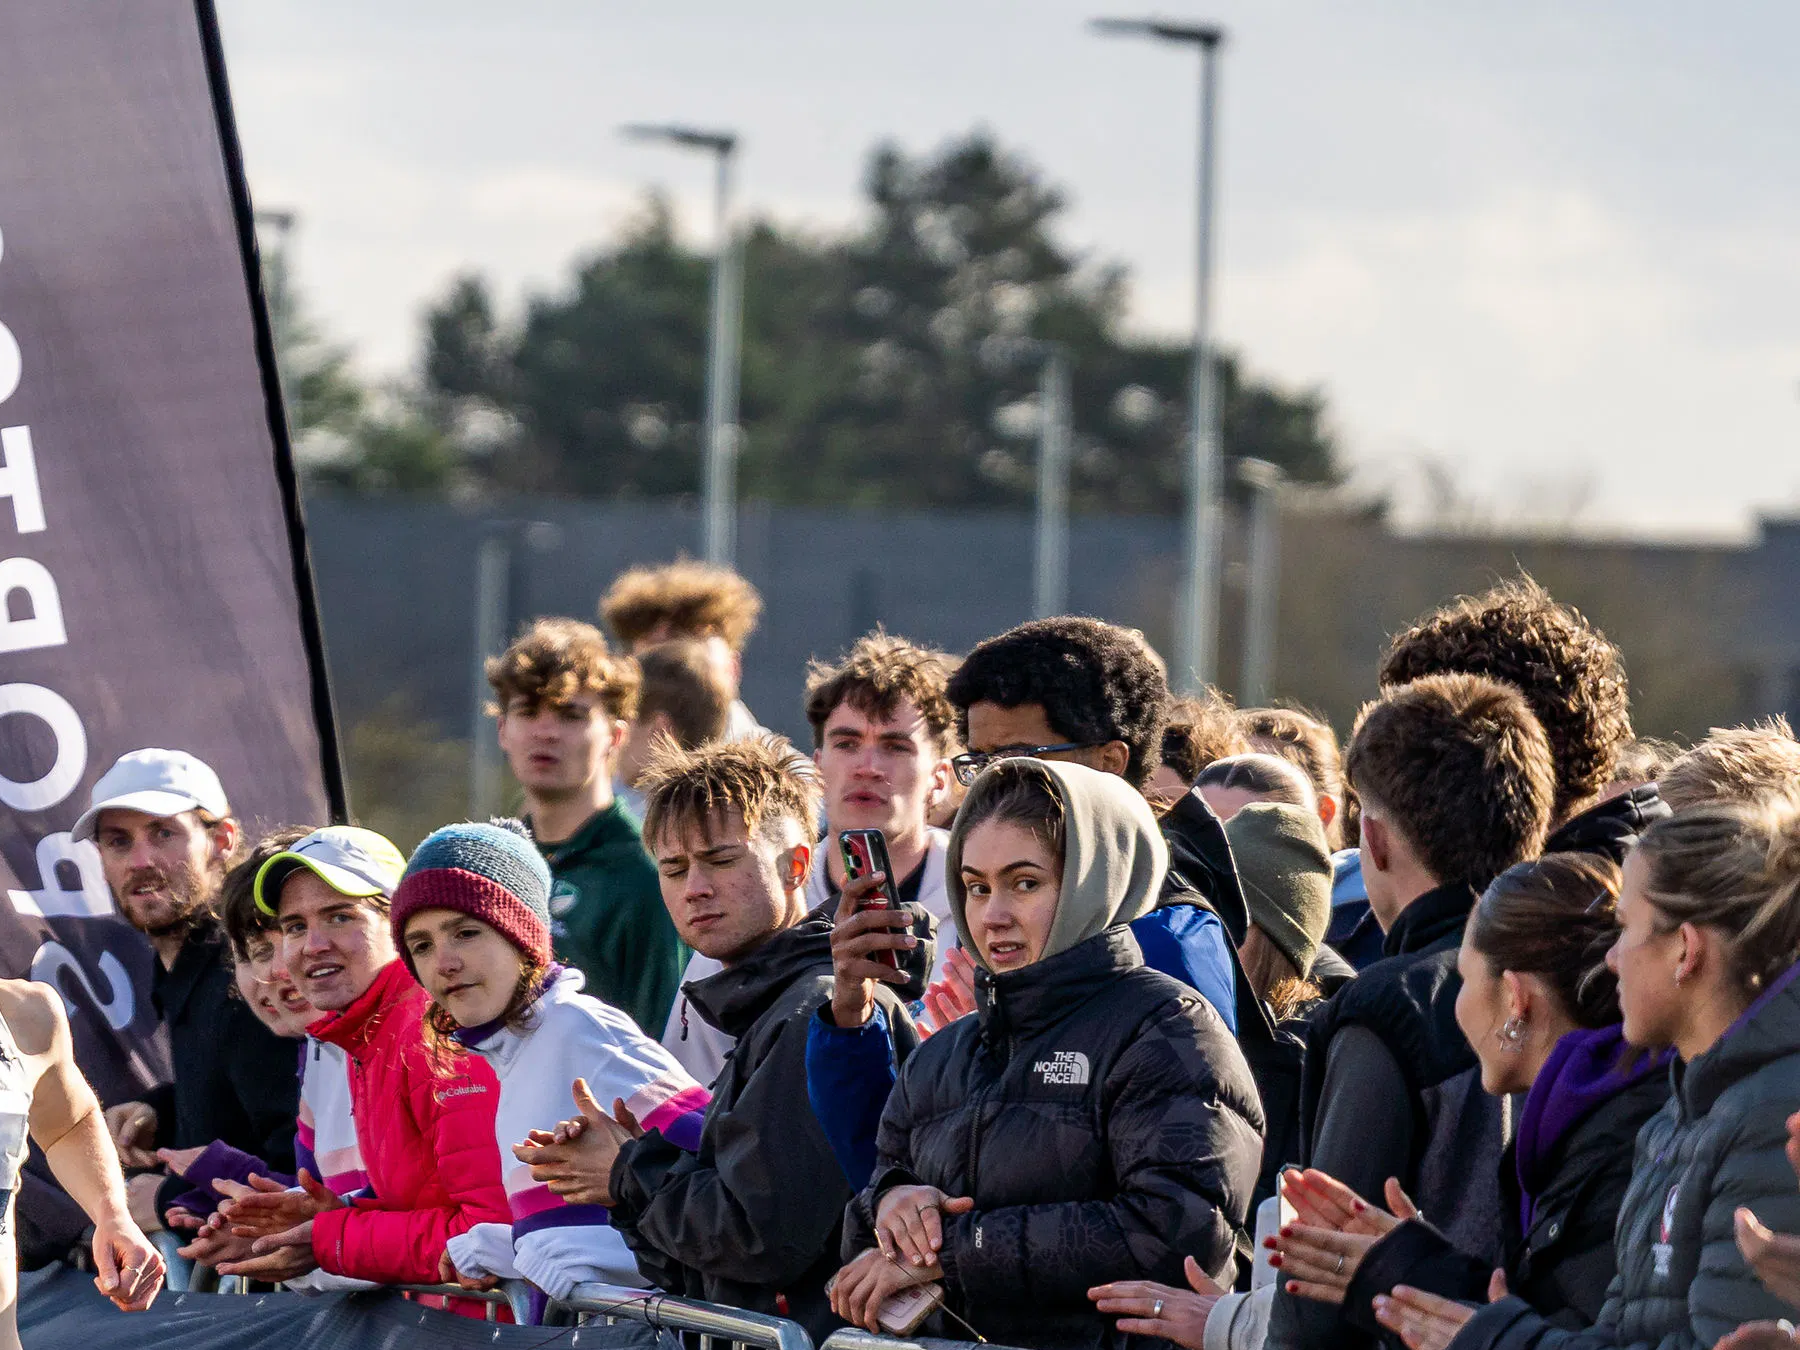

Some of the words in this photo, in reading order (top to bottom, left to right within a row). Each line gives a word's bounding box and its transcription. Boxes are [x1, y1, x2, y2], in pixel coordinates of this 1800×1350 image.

[1053, 1051, 1075, 1062] THE
[1033, 1061, 1072, 1073] NORTH
[1043, 1072, 1071, 1084] FACE
